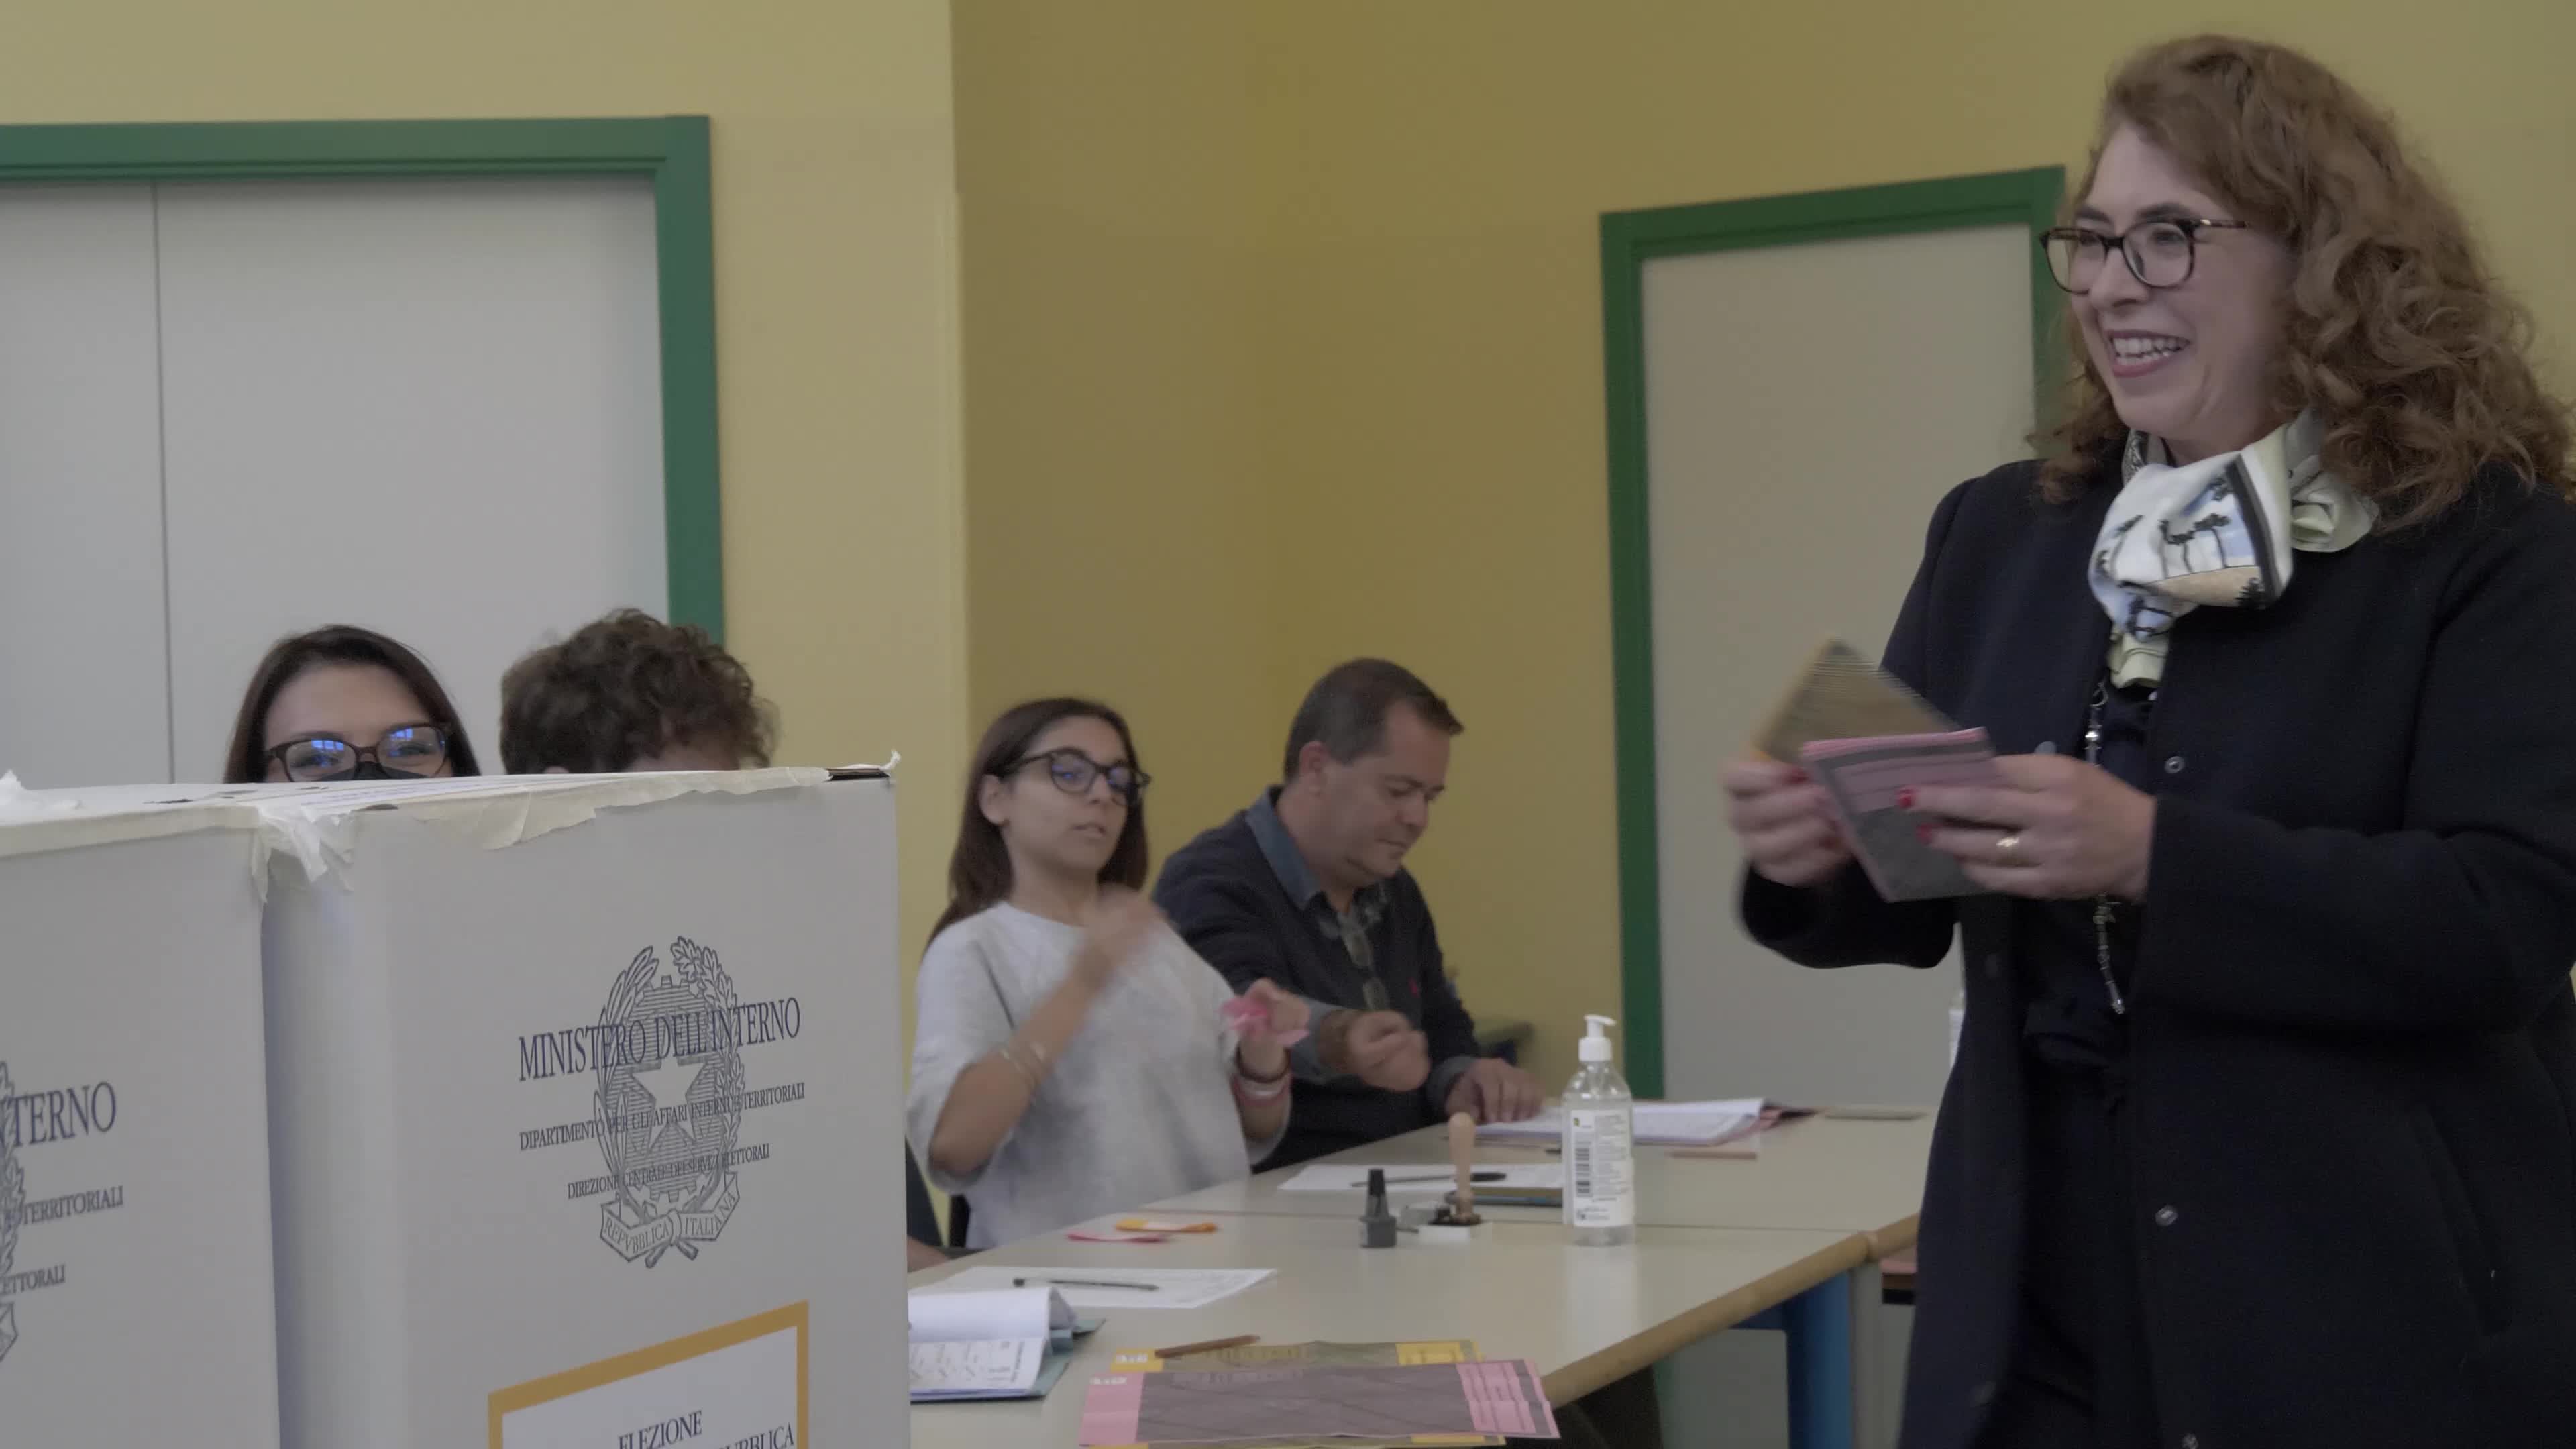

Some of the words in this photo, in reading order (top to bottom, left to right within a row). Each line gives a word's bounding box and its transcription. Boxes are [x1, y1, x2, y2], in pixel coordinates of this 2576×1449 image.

[519, 1020, 646, 1081] MINISTERO
[655, 997, 800, 1060] DELL'INTERNO
[519, 1119, 605, 1152] DIPARTIMENTO
[653, 1105, 688, 1128] AFFARI
[742, 1082, 805, 1110] TERRITORIALI
[24, 1185, 123, 1225] TERRITORIALI
[568, 1175, 621, 1200] DIREZIONE
[685, 1191, 735, 1235] ITALIANA
[0, 1264, 66, 1295] ETTORALI
